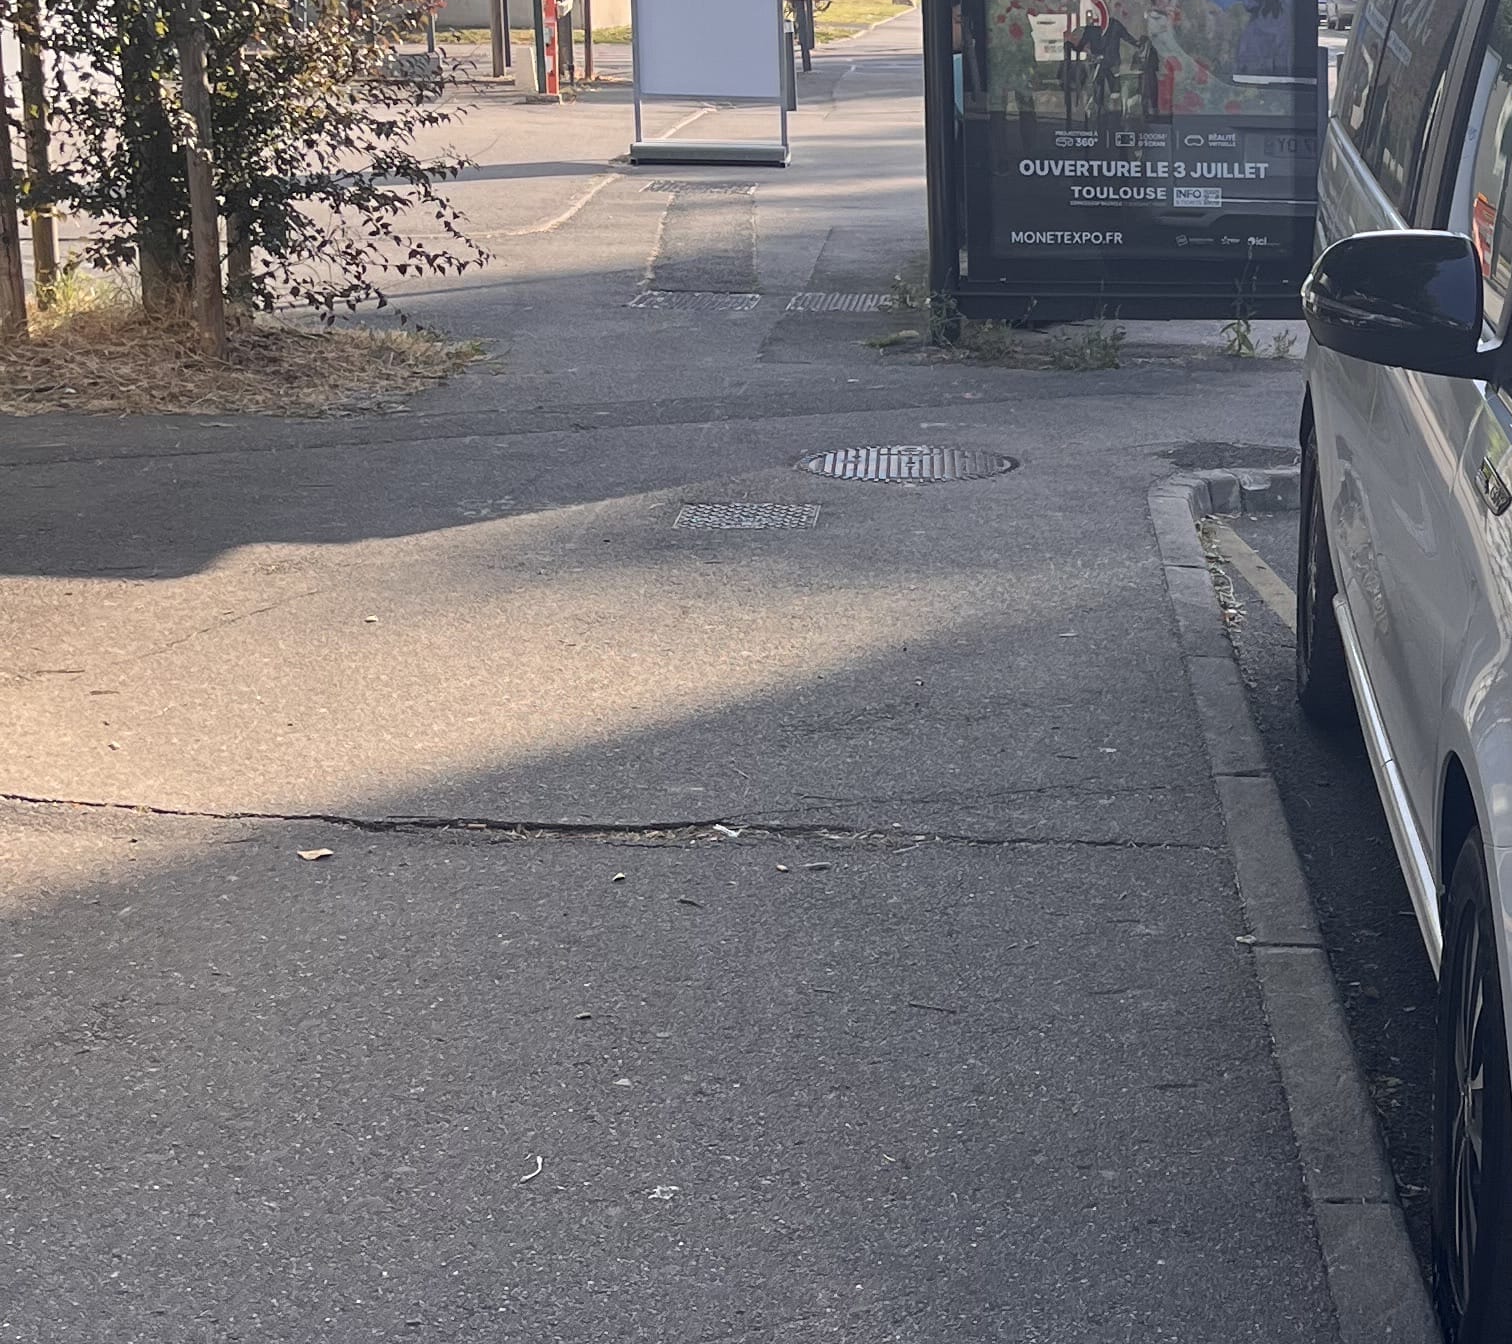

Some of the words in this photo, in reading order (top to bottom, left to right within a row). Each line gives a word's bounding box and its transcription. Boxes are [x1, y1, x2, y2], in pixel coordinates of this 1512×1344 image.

[1075, 137, 1098, 147] 360°
[1019, 159, 1142, 177] OUVERTURE
[1146, 162, 1169, 178] LE
[1174, 162, 1186, 178] 3
[1190, 162, 1269, 179] JUILLET
[1070, 186, 1167, 200] TOULOUSE
[1176, 189, 1202, 198] INFO
[1011, 231, 1123, 244] MONETEXPO.FR
